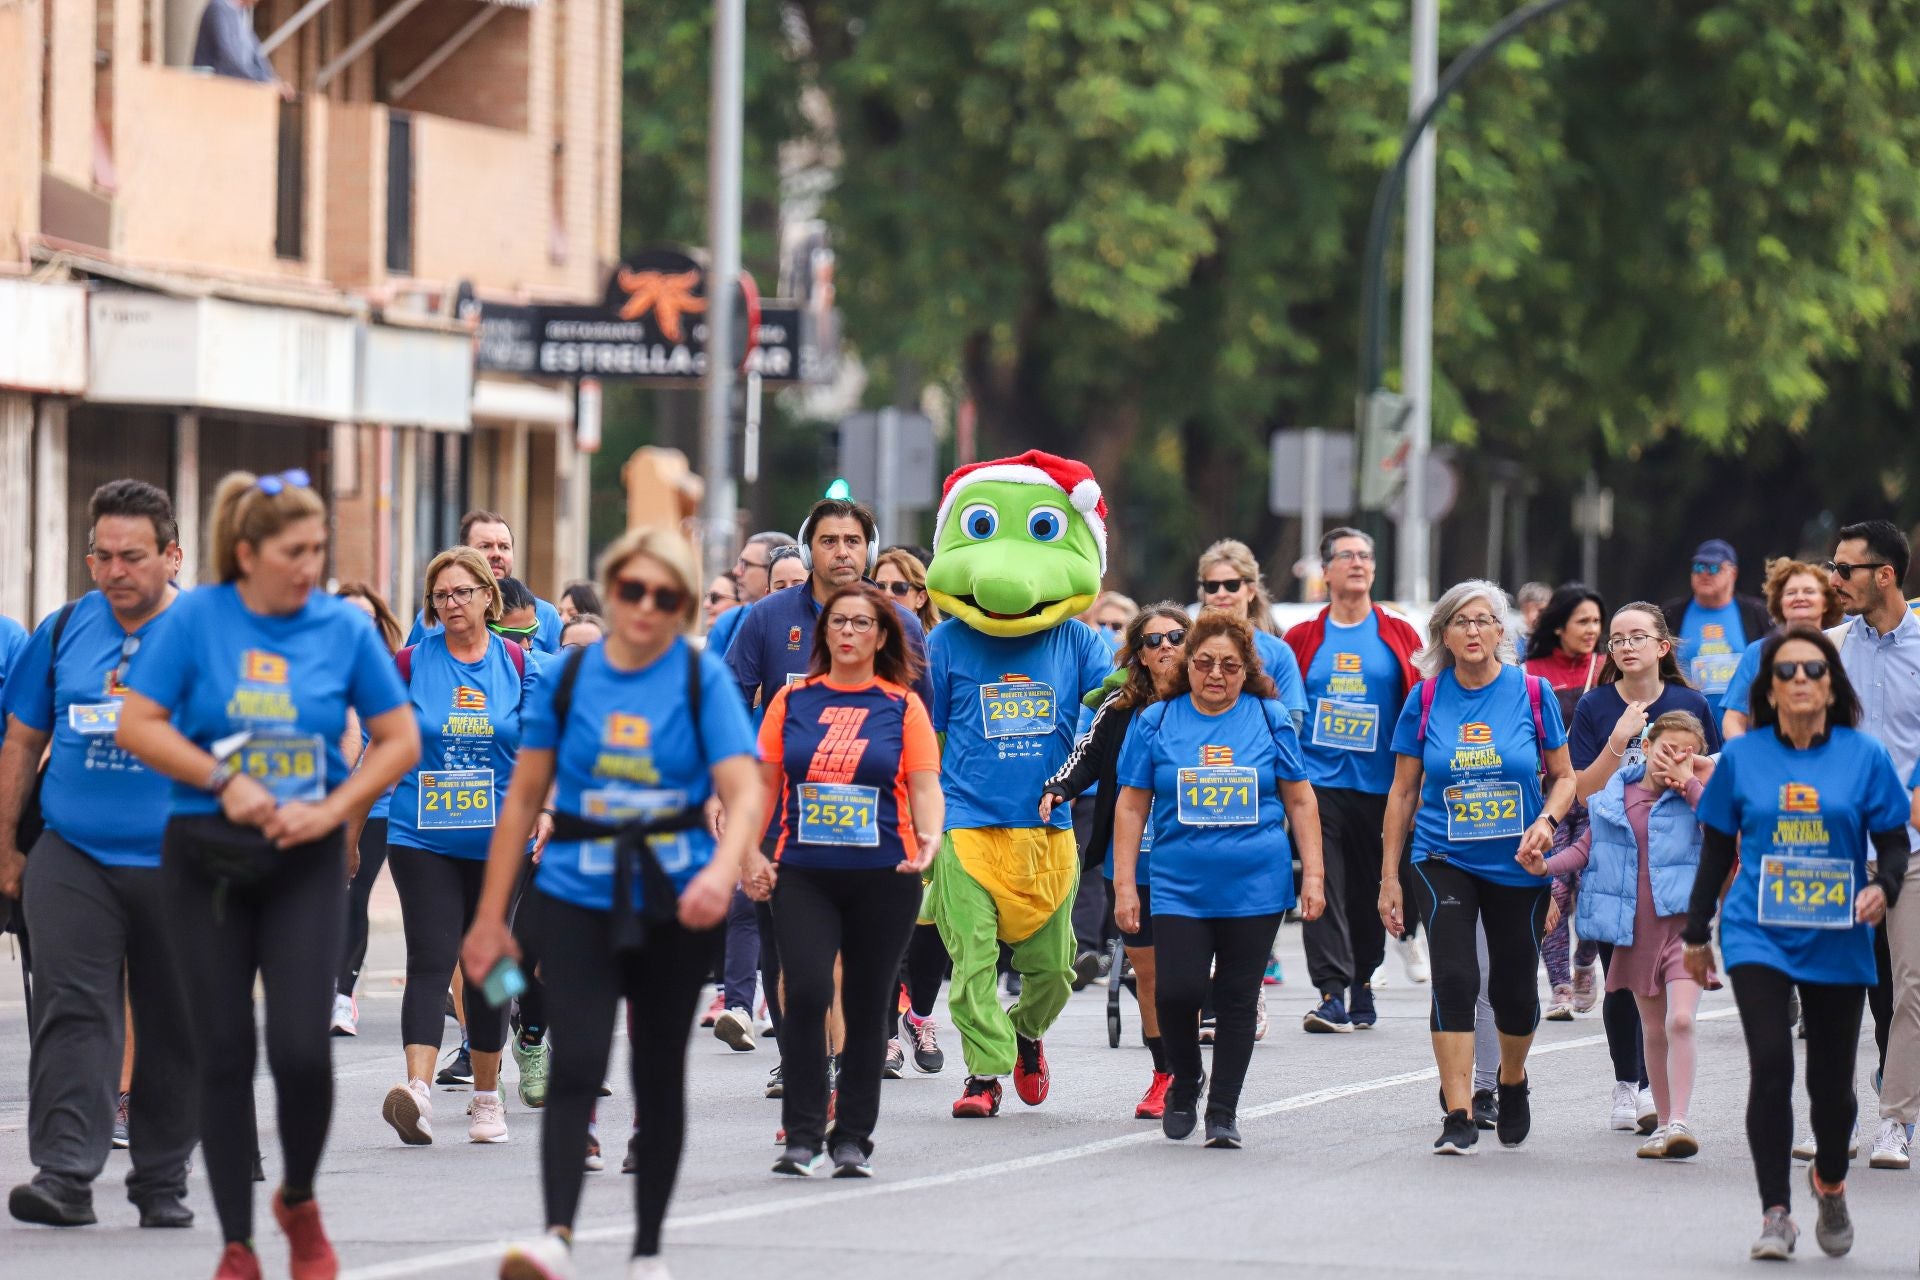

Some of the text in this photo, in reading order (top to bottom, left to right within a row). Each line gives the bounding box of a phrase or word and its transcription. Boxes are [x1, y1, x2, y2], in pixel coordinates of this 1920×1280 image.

[541, 343, 690, 373] ESTRELLA
[989, 699, 1050, 720] 2932
[451, 724, 495, 735] VALENCIA
[1321, 715, 1372, 736] 1577
[1459, 755, 1502, 768] VALENCIA
[425, 789, 488, 811] 2156
[1186, 786, 1248, 806] 1271
[806, 803, 868, 829] 2521
[1454, 799, 1517, 822] 2532
[1770, 879, 1846, 907] 1324
